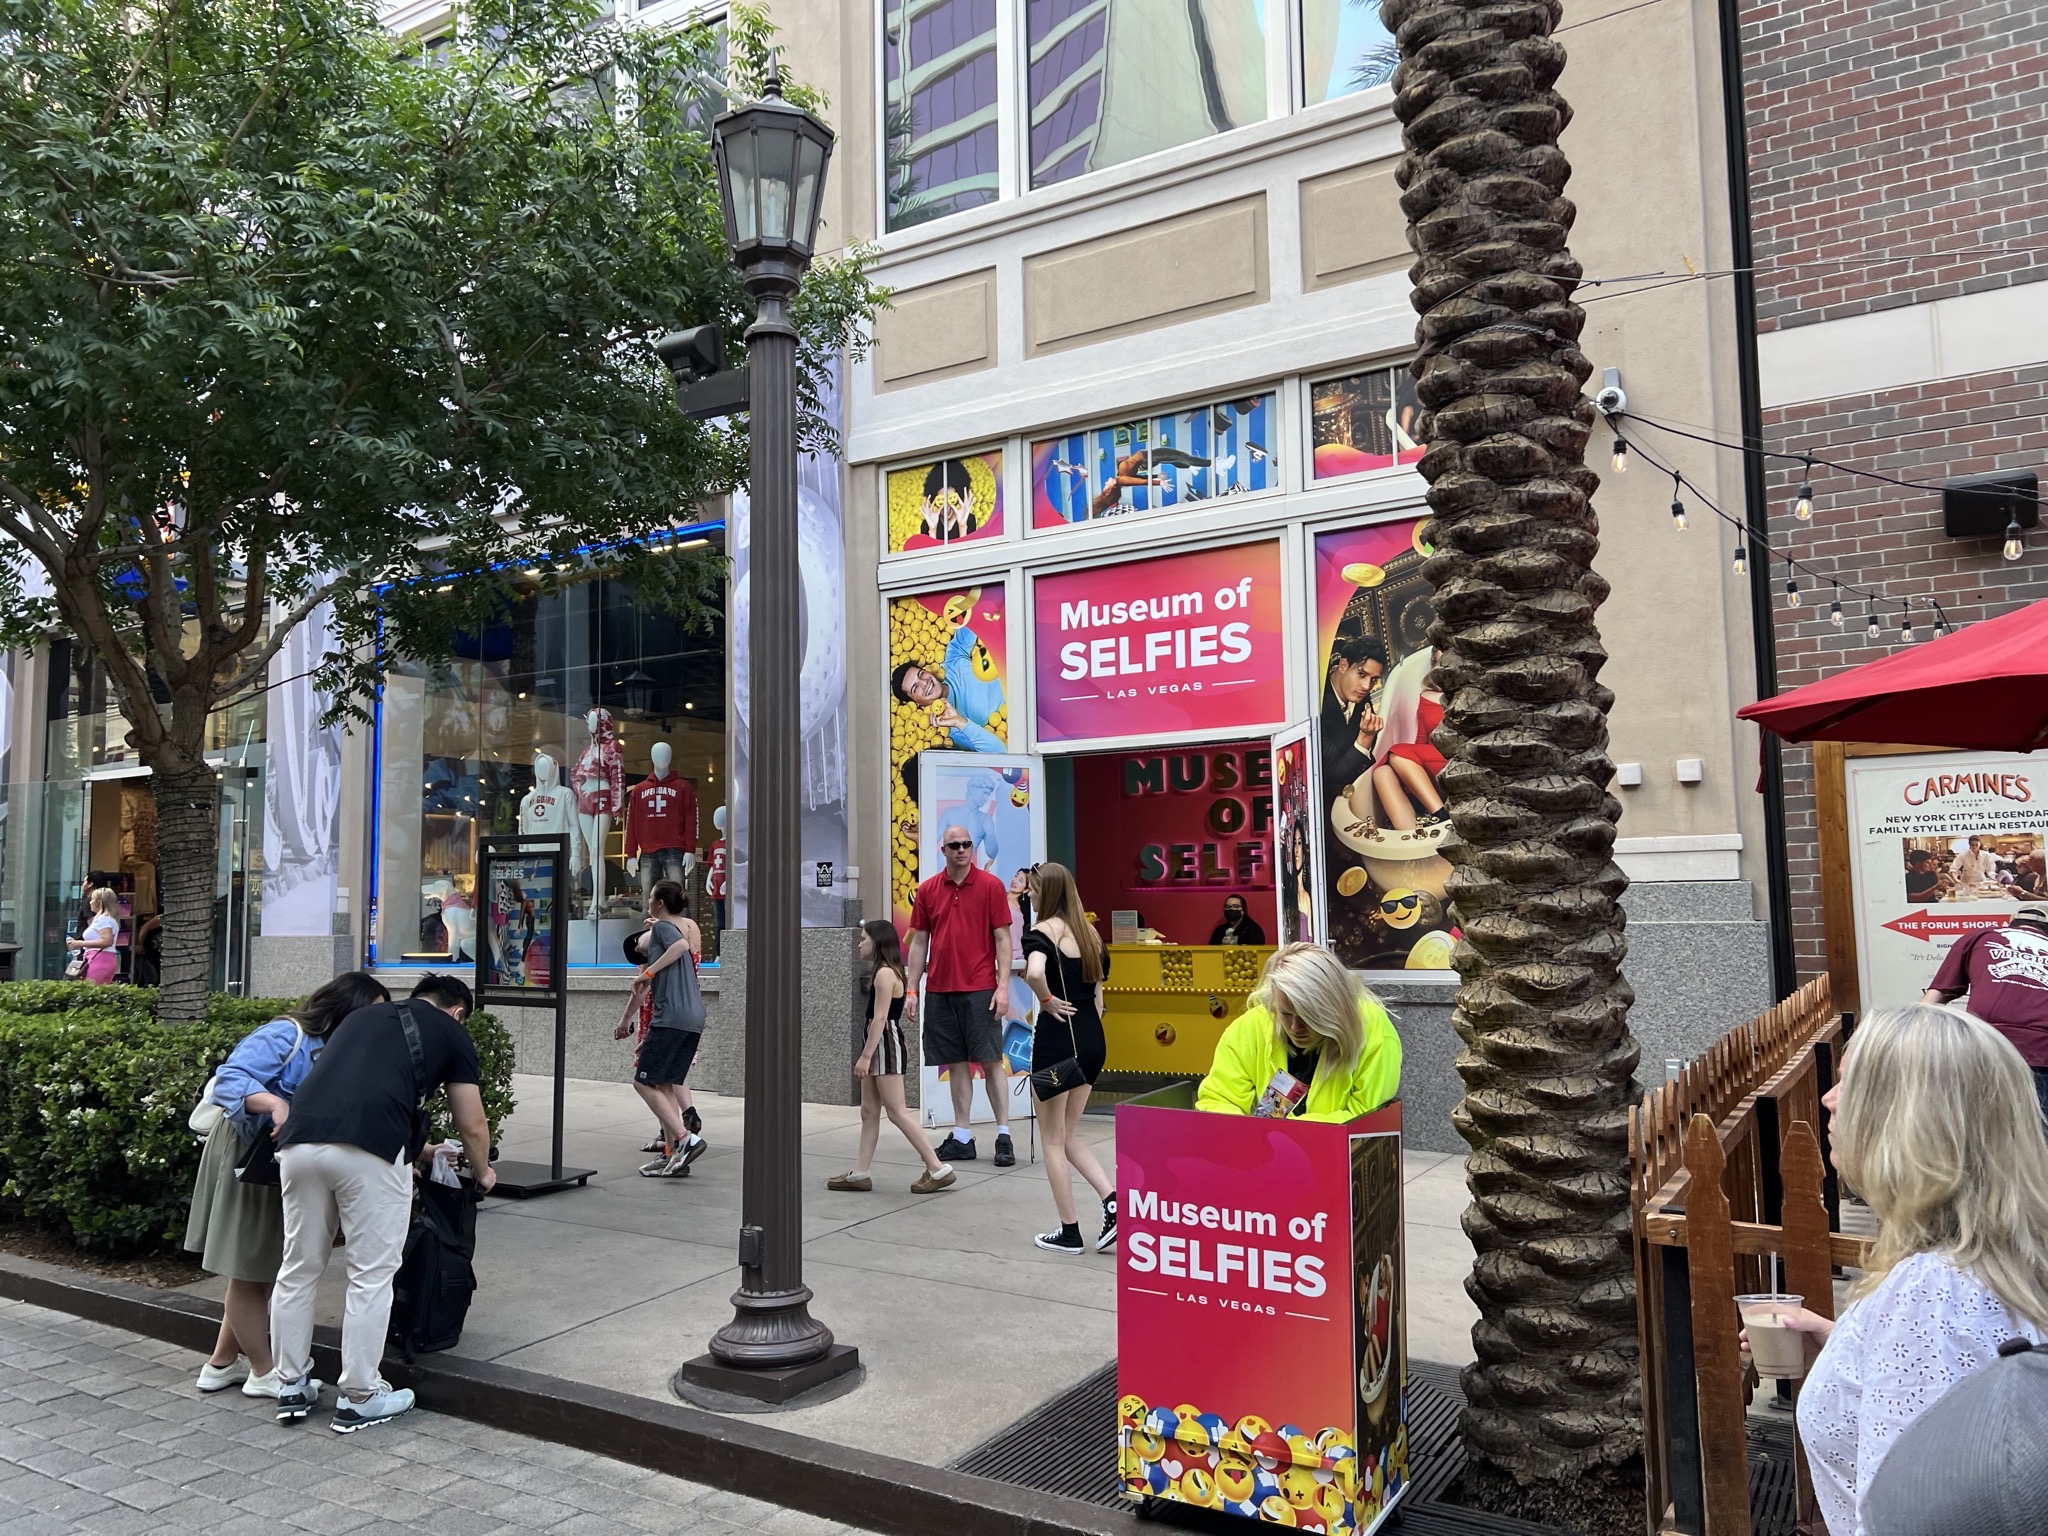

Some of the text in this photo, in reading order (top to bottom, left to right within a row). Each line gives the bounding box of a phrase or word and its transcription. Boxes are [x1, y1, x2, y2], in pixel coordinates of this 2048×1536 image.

[1060, 577, 1252, 630] Museum of
[1060, 622, 1252, 680] SELFIES
[1107, 682, 1203, 699] LAS VEGAS
[1903, 773, 2032, 806] CARMINE'S
[1208, 796, 1274, 833] OF
[1869, 825, 1909, 834] FAMILY
[1913, 825, 1947, 833] STYLE
[1950, 822, 1996, 831] ITALIAN
[1915, 814, 1946, 822] YORK
[1949, 812, 1985, 821] CITY'S
[491, 869, 524, 879] SELFIES
[1140, 842, 1274, 880] SELF
[1898, 922, 1918, 930] THE
[1962, 921, 1998, 929] SHOPS
[1128, 1188, 1328, 1243] Museum of
[1127, 1231, 1327, 1298] SELFIES
[1176, 1292, 1276, 1315] LAS VEGAS
